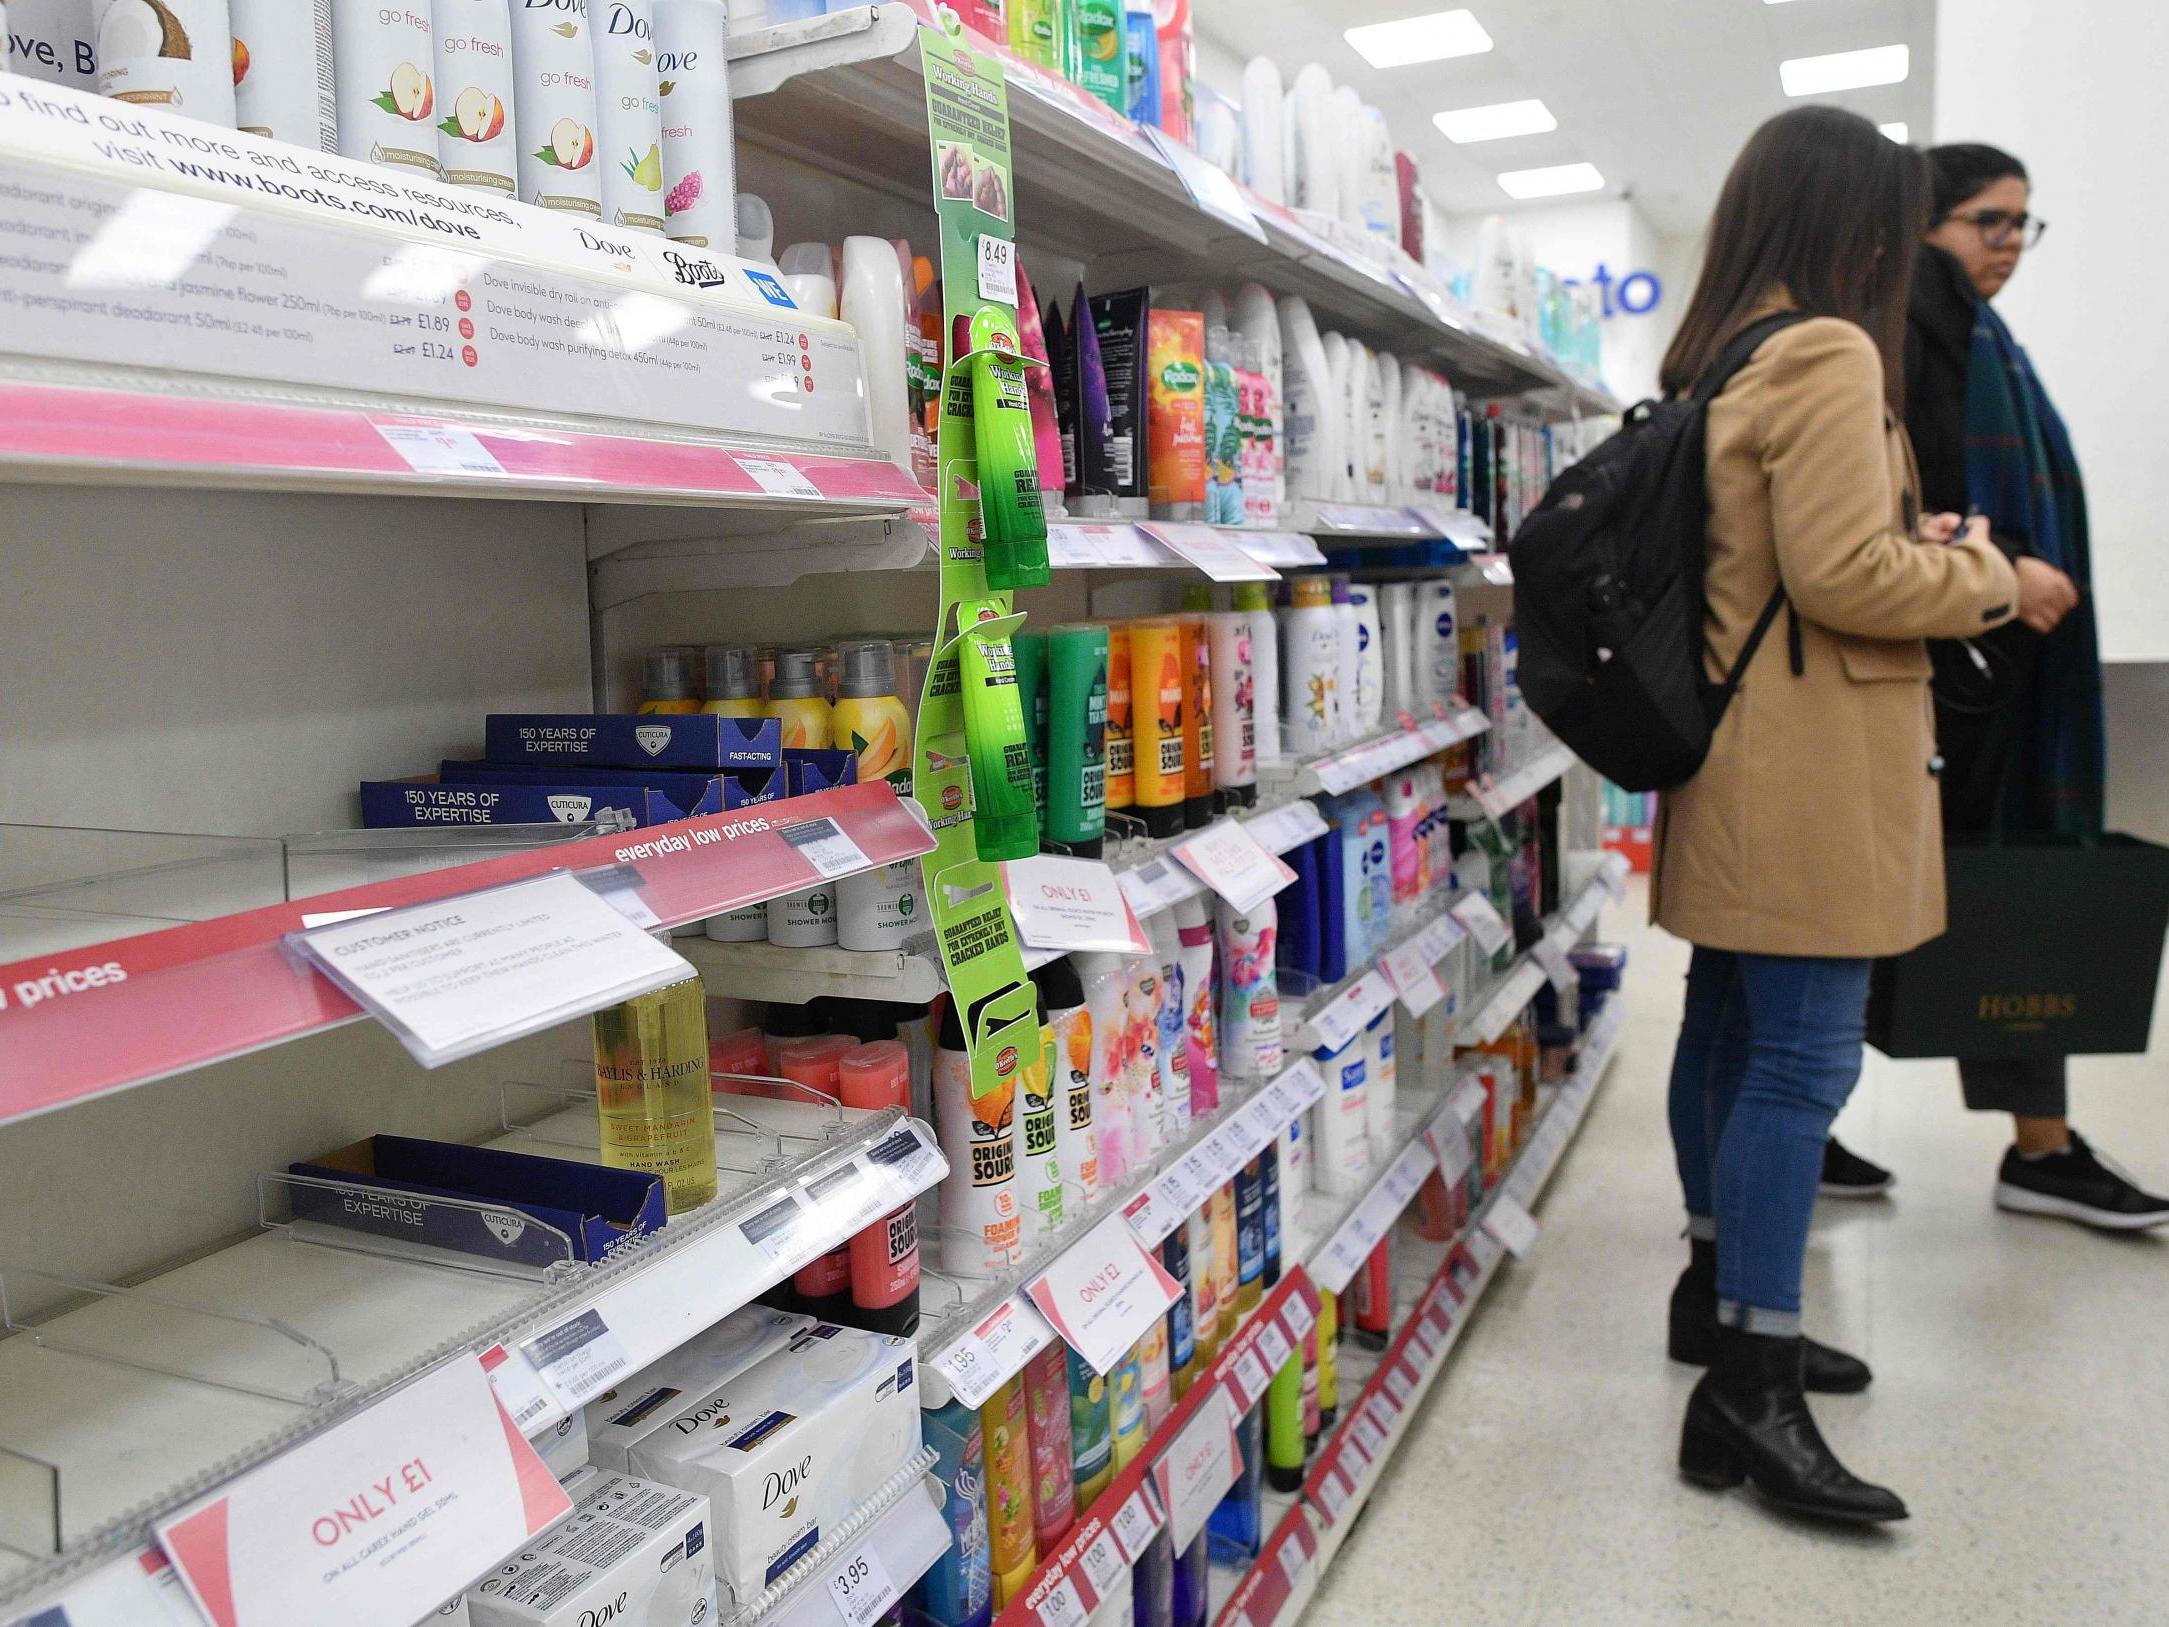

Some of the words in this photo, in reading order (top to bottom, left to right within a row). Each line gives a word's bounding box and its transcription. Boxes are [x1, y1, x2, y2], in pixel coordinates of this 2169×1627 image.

[379, 9, 402, 26] go
[525, 0, 587, 18] ove
[607, 2, 652, 41] Dov
[444, 38, 467, 54] go
[471, 37, 504, 58] fresh
[657, 50, 698, 73] ove
[540, 71, 561, 87] go
[564, 71, 592, 92] fresh
[932, 63, 972, 97] Working
[971, 82, 999, 106] Hands
[621, 95, 640, 110] go
[642, 97, 660, 114] fres
[661, 124, 693, 139] fresh
[19, 91, 90, 125] find
[99, 114, 156, 141] out
[160, 128, 241, 160] more
[250, 151, 303, 175] and
[306, 164, 399, 198] access
[401, 185, 523, 229] resources,
[92, 140, 165, 170] visit
[167, 157, 482, 240] www.boots.com/dove
[451, 172, 498, 187] moisturising
[573, 227, 636, 260] Dove
[663, 251, 726, 286] Boots
[179, 279, 235, 302] jasmine
[238, 288, 279, 307] flower
[281, 293, 320, 313] 250ml
[418, 313, 450, 333] £1.89
[484, 272, 509, 290] Dove
[511, 281, 547, 298] invisible
[549, 288, 563, 305] dry
[697, 316, 717, 330] 50ml
[776, 331, 796, 346] £1.24
[112, 304, 193, 326] deodorant
[195, 312, 233, 332] 50ml
[422, 342, 454, 362] £1.24
[487, 300, 513, 317] Dove
[515, 308, 538, 322] body
[540, 313, 563, 326] wash
[777, 353, 797, 367] £1.99
[490, 328, 516, 344] Dove
[517, 335, 541, 350] body
[542, 340, 566, 352] wash
[567, 344, 607, 361] purifying
[608, 349, 632, 362] detox
[633, 352, 659, 366] 450ml
[988, 658, 1015, 672] Hands
[519, 727, 536, 739] 150
[538, 727, 577, 739] YEARS
[580, 728, 596, 740] OF
[526, 741, 589, 753] EXPERTISE
[404, 790, 426, 804] 150
[428, 791, 476, 807] YEARS
[479, 793, 500, 807] OF
[551, 800, 589, 811] CUTICURA
[414, 807, 492, 823] EXPERTISE
[957, 810, 973, 824] Han
[615, 832, 690, 864] everyday
[688, 824, 722, 846] low
[726, 815, 771, 841] prices
[1040, 884, 1077, 900] ONLY
[729, 912, 765, 922] SHOWER
[787, 917, 821, 927] SHOWER
[822, 916, 838, 926] MOU
[877, 920, 908, 930] SHOWER
[944, 916, 982, 940] GUARANTEED
[982, 907, 1002, 923] RELIEF
[334, 925, 412, 958] CUSTOMER
[413, 914, 467, 937] NOTICE
[947, 940, 961, 953] FOR
[961, 926, 996, 948] EXTREMELY
[951, 943, 985, 967] CRACKED
[985, 931, 1010, 951] HANDS
[14, 960, 129, 1009] prices
[1979, 994, 2078, 1021] HOBBS
[637, 1071, 649, 1081] &
[650, 1056, 705, 1081] HARDING
[610, 1122, 640, 1132] SWEET
[643, 1118, 695, 1132] MANDARIN
[1070, 1104, 1091, 1124] SOU
[626, 1129, 689, 1142] GRAPEFRUIT
[655, 1158, 680, 1167] WASH
[973, 1155, 1014, 1180] SOUR
[1038, 1183, 1063, 1201] FOAM
[343, 1198, 425, 1226] EXPERTISE
[484, 1214, 523, 1230] CUTICURA
[602, 1240, 615, 1251] 150
[614, 1229, 638, 1245] YEARS
[638, 1220, 648, 1231] OF
[1079, 1271, 1110, 1303] ONLY
[668, 1398, 730, 1435] Dove
[762, 1455, 812, 1511] Dove
[311, 1475, 398, 1548] ONLY
[400, 1457, 433, 1494] £1
[1024, 1562, 1065, 1611] everyday
[1058, 1543, 1078, 1568] low
[1074, 1516, 1102, 1553] prices
[577, 1590, 628, 1627] Dove
